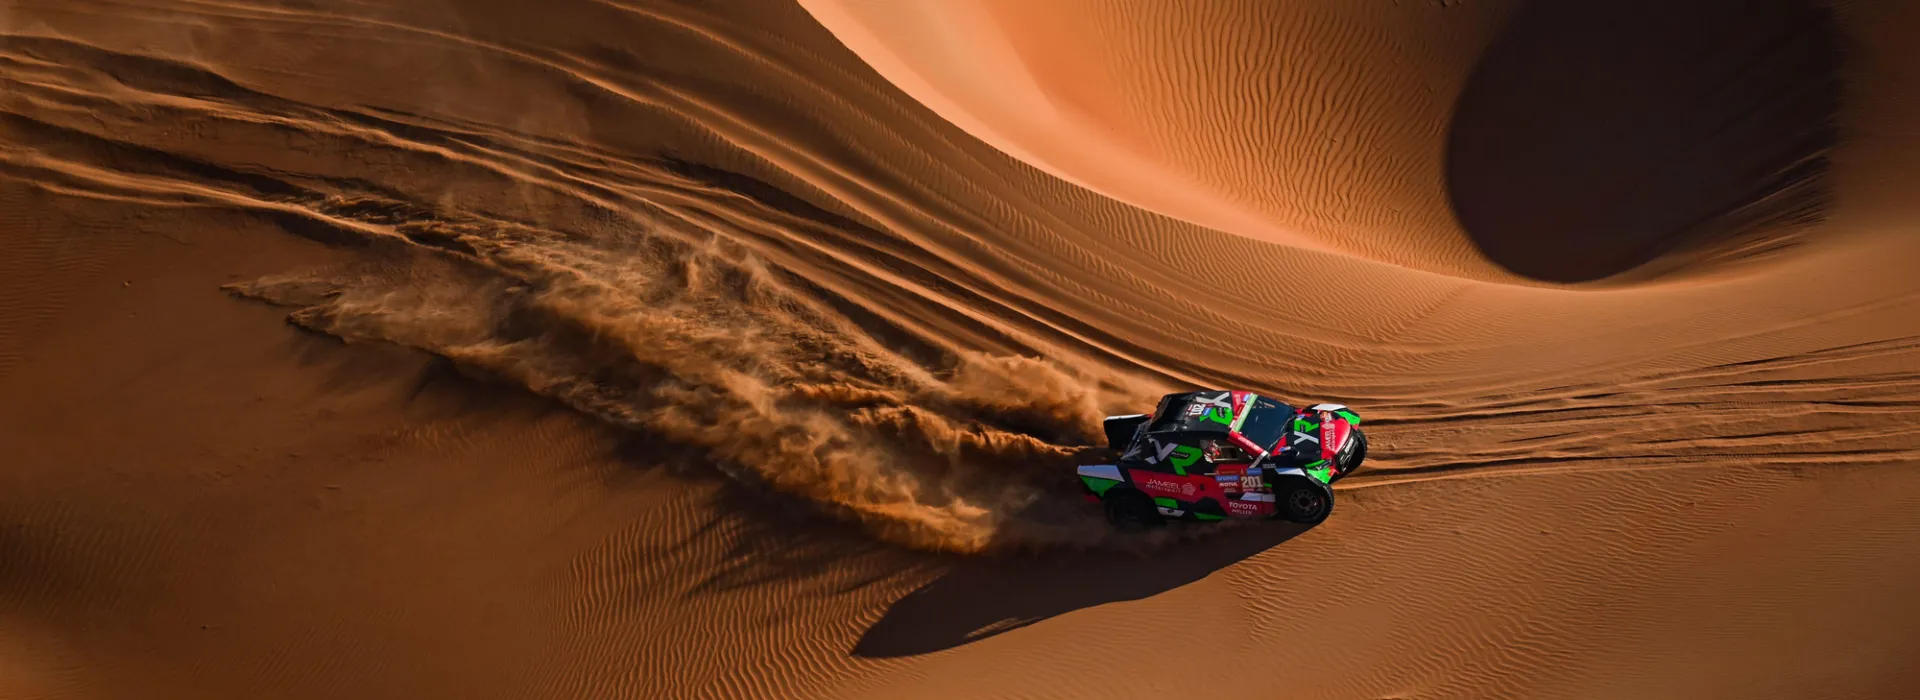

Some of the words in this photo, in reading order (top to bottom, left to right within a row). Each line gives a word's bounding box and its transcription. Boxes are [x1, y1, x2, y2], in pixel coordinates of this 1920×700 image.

[1146, 479, 1181, 489] JAMEEL
[1241, 476, 1264, 488] 201
[1228, 502, 1258, 511] TOYOTA
